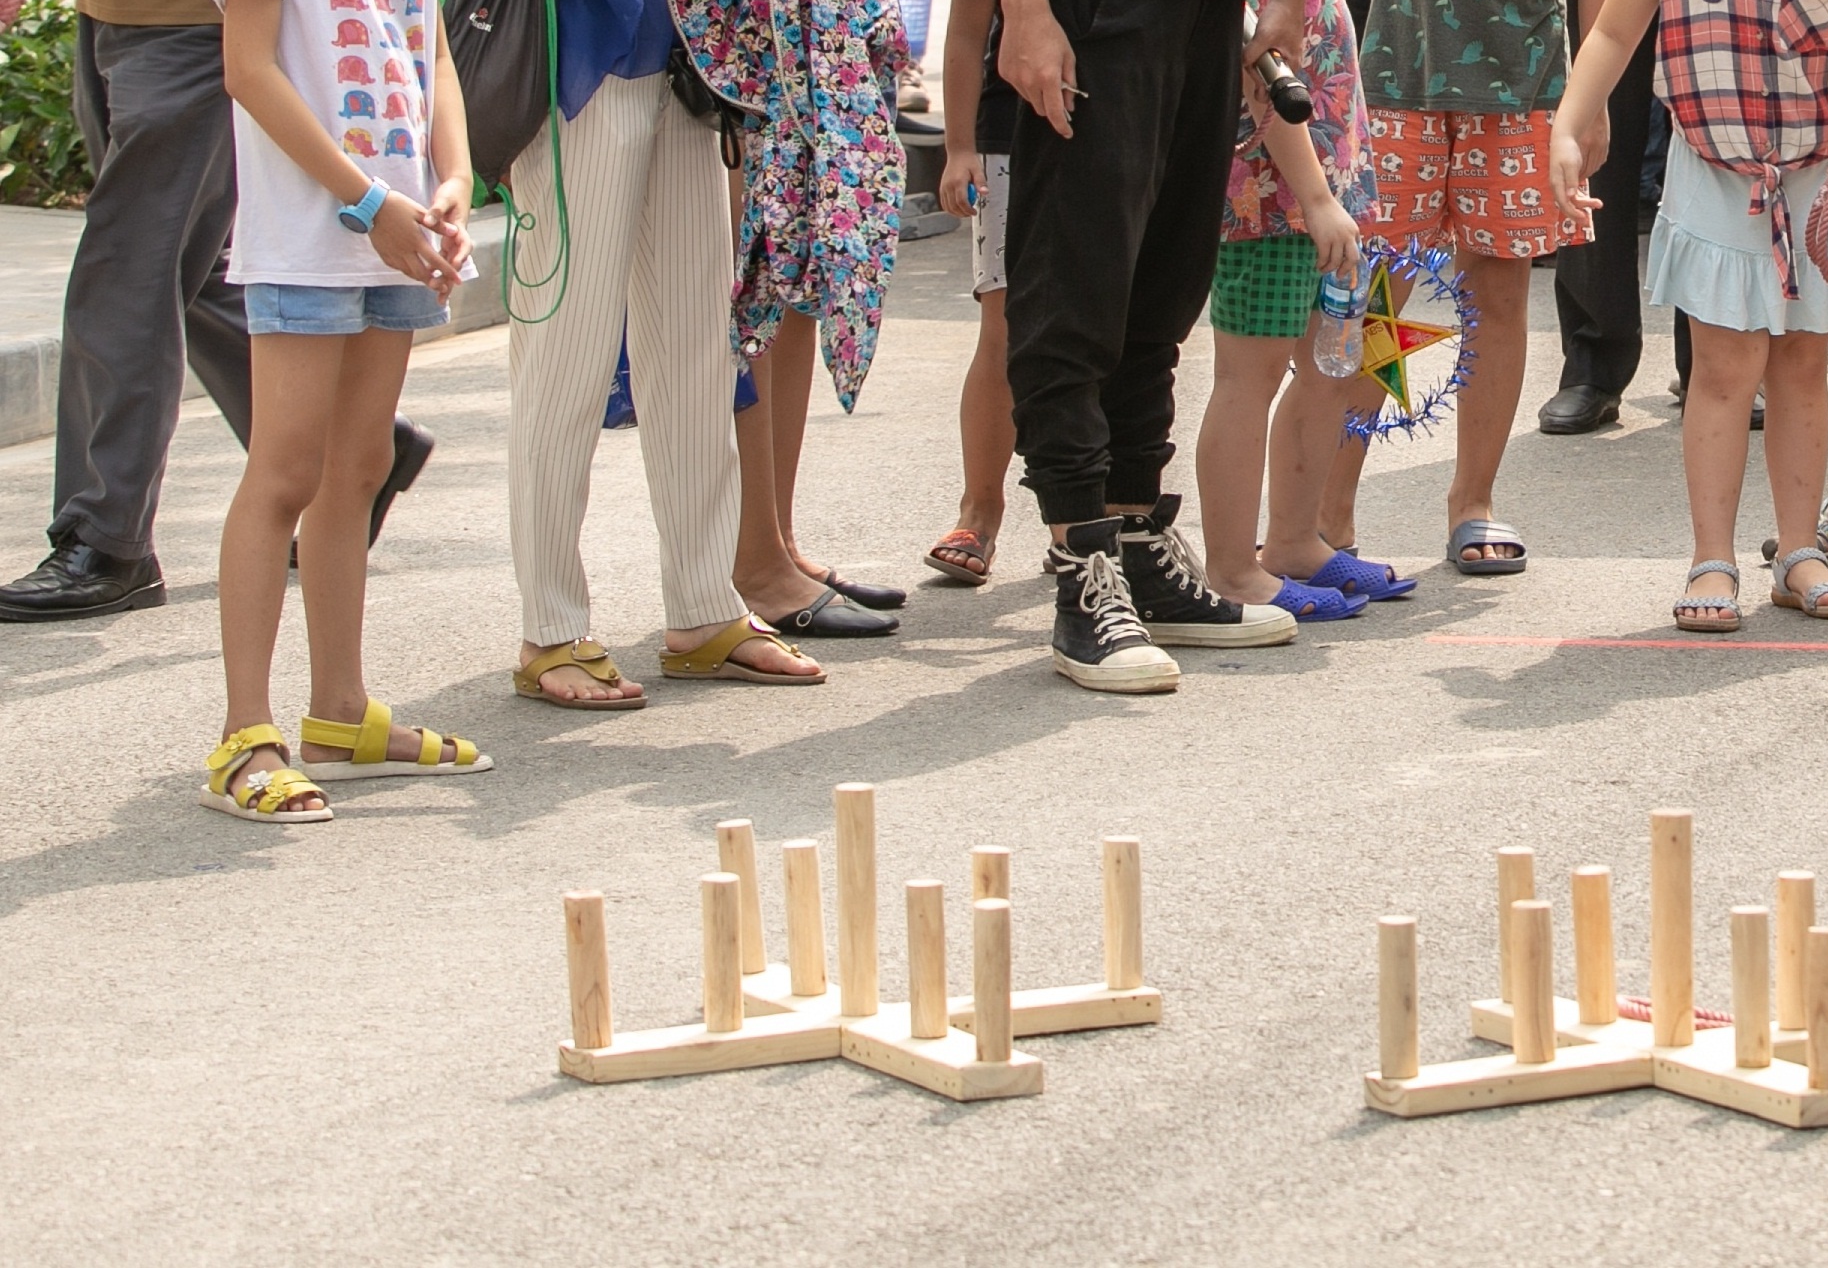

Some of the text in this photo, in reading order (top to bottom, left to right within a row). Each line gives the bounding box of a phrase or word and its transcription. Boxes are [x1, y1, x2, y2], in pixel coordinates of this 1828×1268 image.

[1498, 124, 1533, 136] SOCCER
[1422, 136, 1449, 145] SOCC
[1376, 173, 1402, 182] CCER
[1504, 207, 1545, 218] SOCCER
